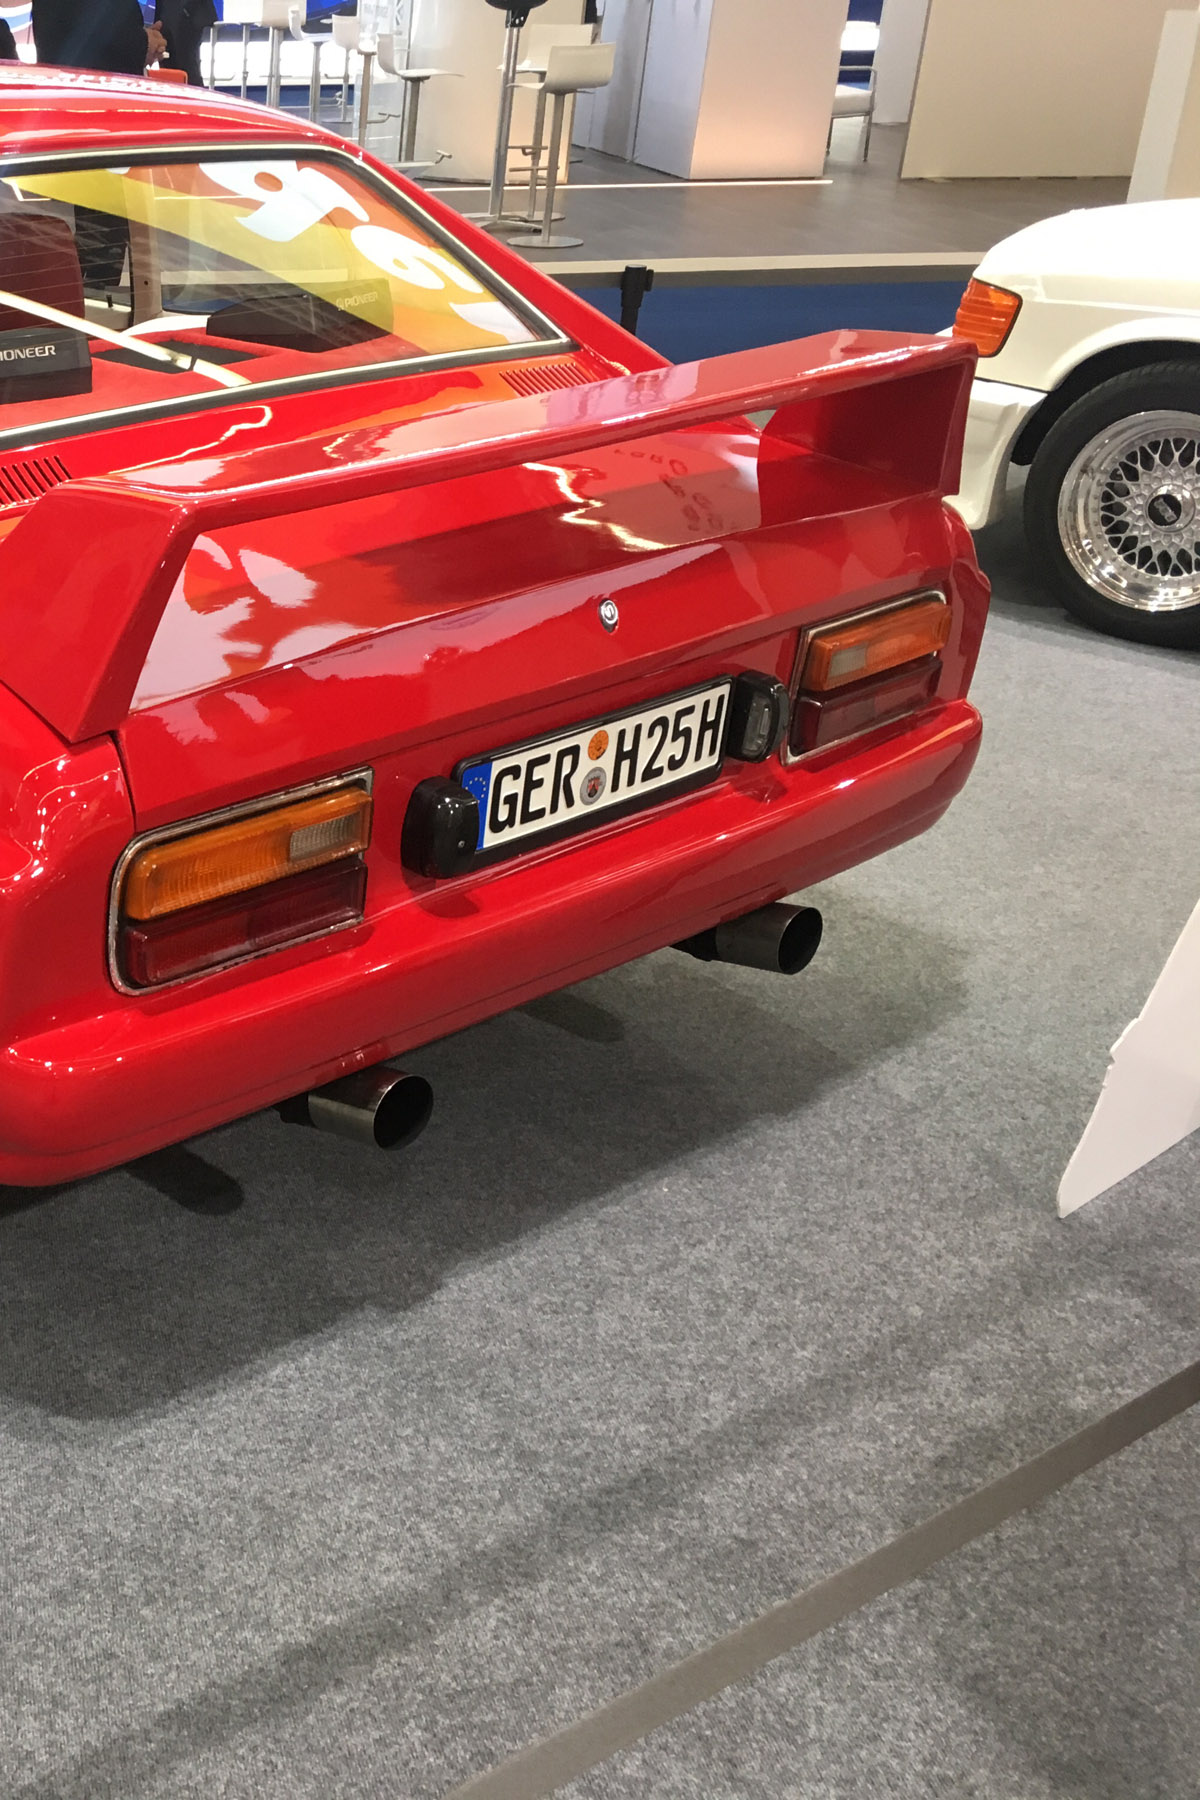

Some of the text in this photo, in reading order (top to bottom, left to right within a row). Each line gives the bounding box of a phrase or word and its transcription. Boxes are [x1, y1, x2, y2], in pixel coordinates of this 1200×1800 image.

[344, 291, 379, 308] PIONEER
[488, 693, 726, 834] GER H25H
